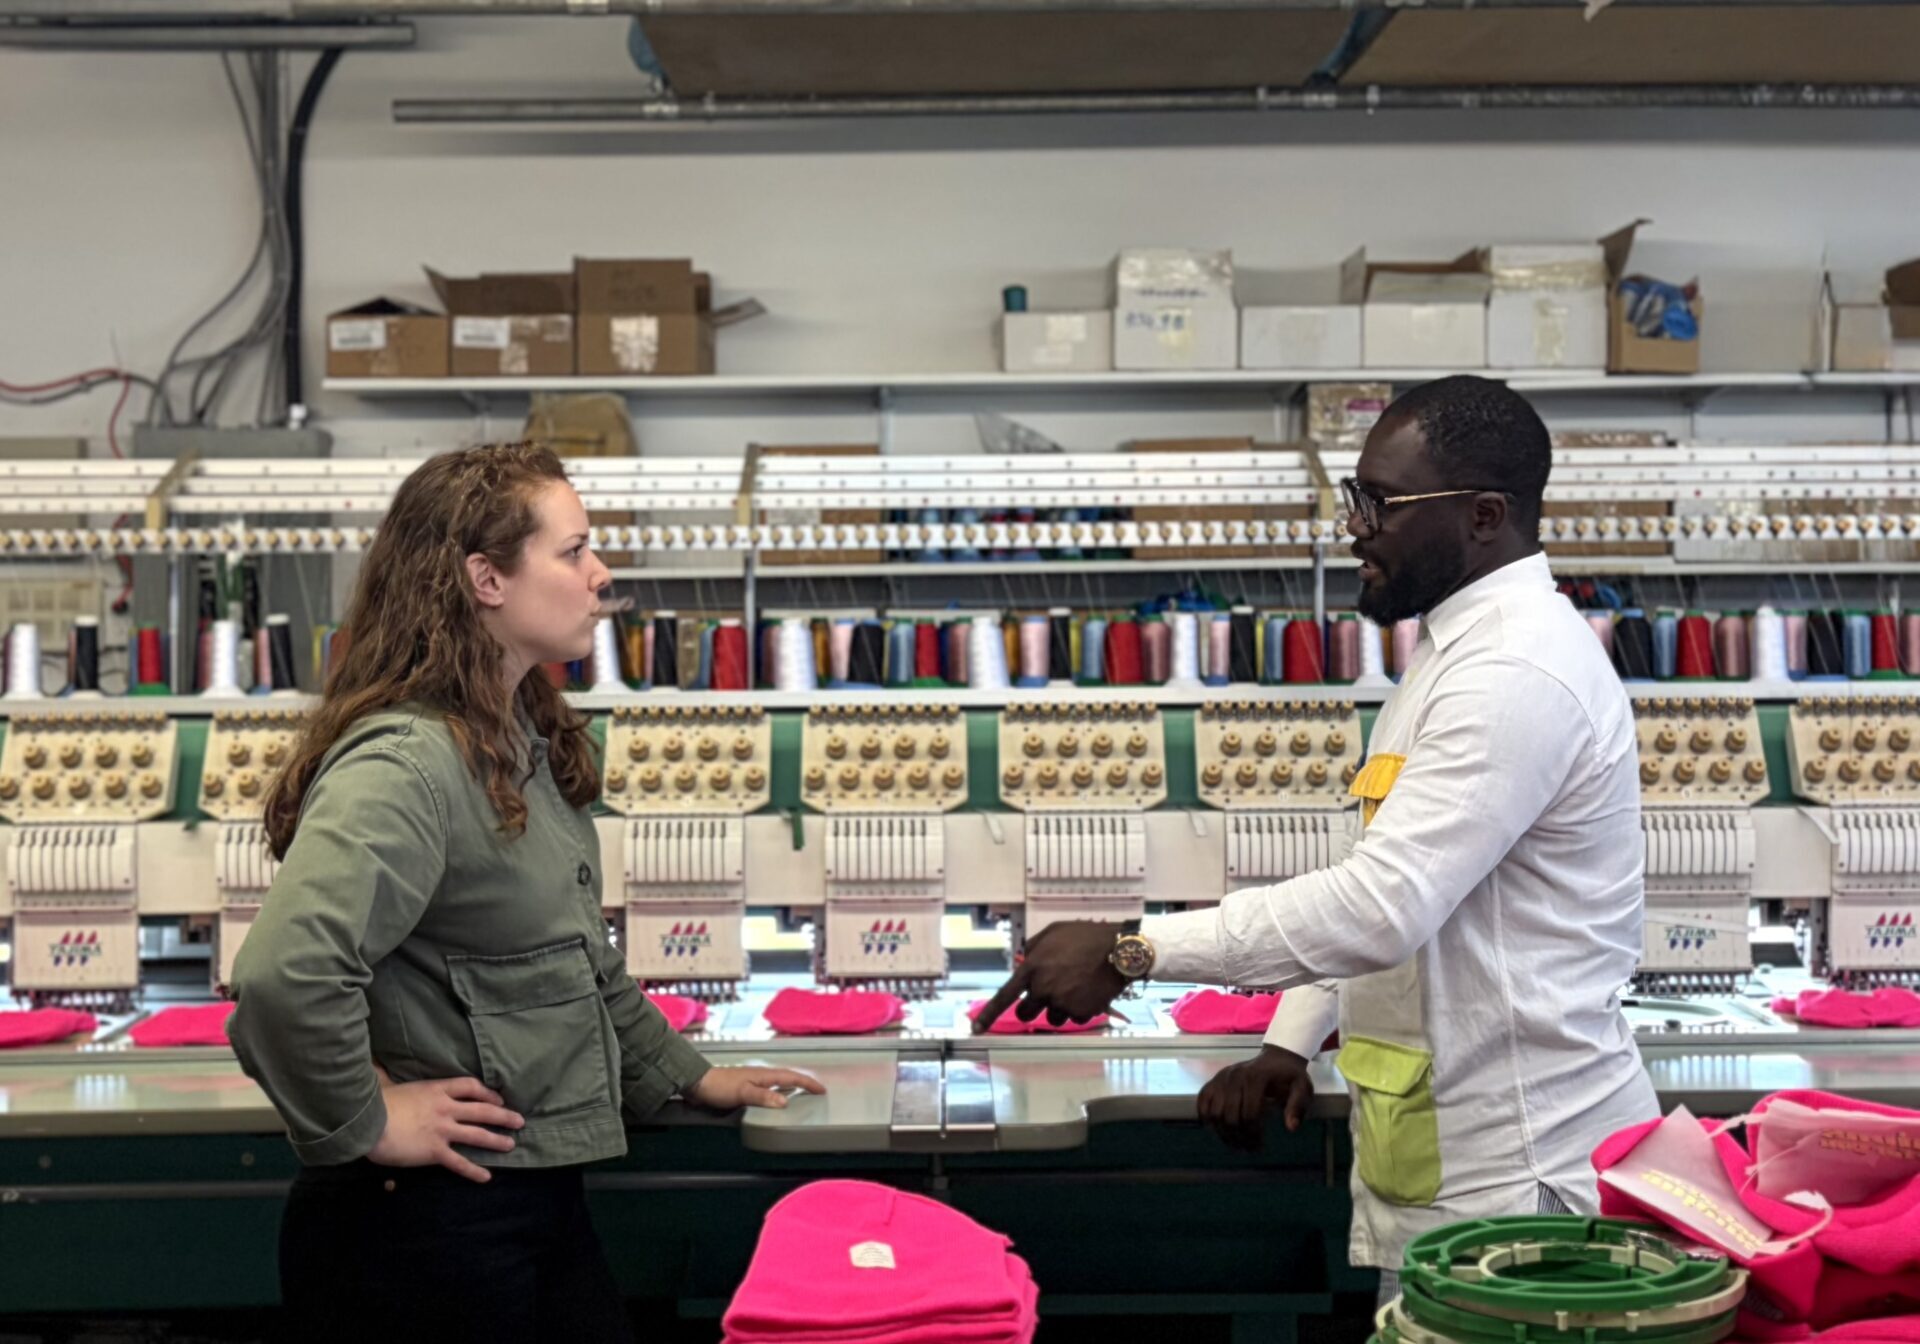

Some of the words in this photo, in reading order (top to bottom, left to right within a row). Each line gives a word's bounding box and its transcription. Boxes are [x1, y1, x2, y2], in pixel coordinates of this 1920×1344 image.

[1666, 927, 1717, 939] TAJIMA
[1866, 926, 1916, 938] TAJIMA
[660, 935, 711, 945] TAJIMA
[860, 933, 911, 944] TAJIMA
